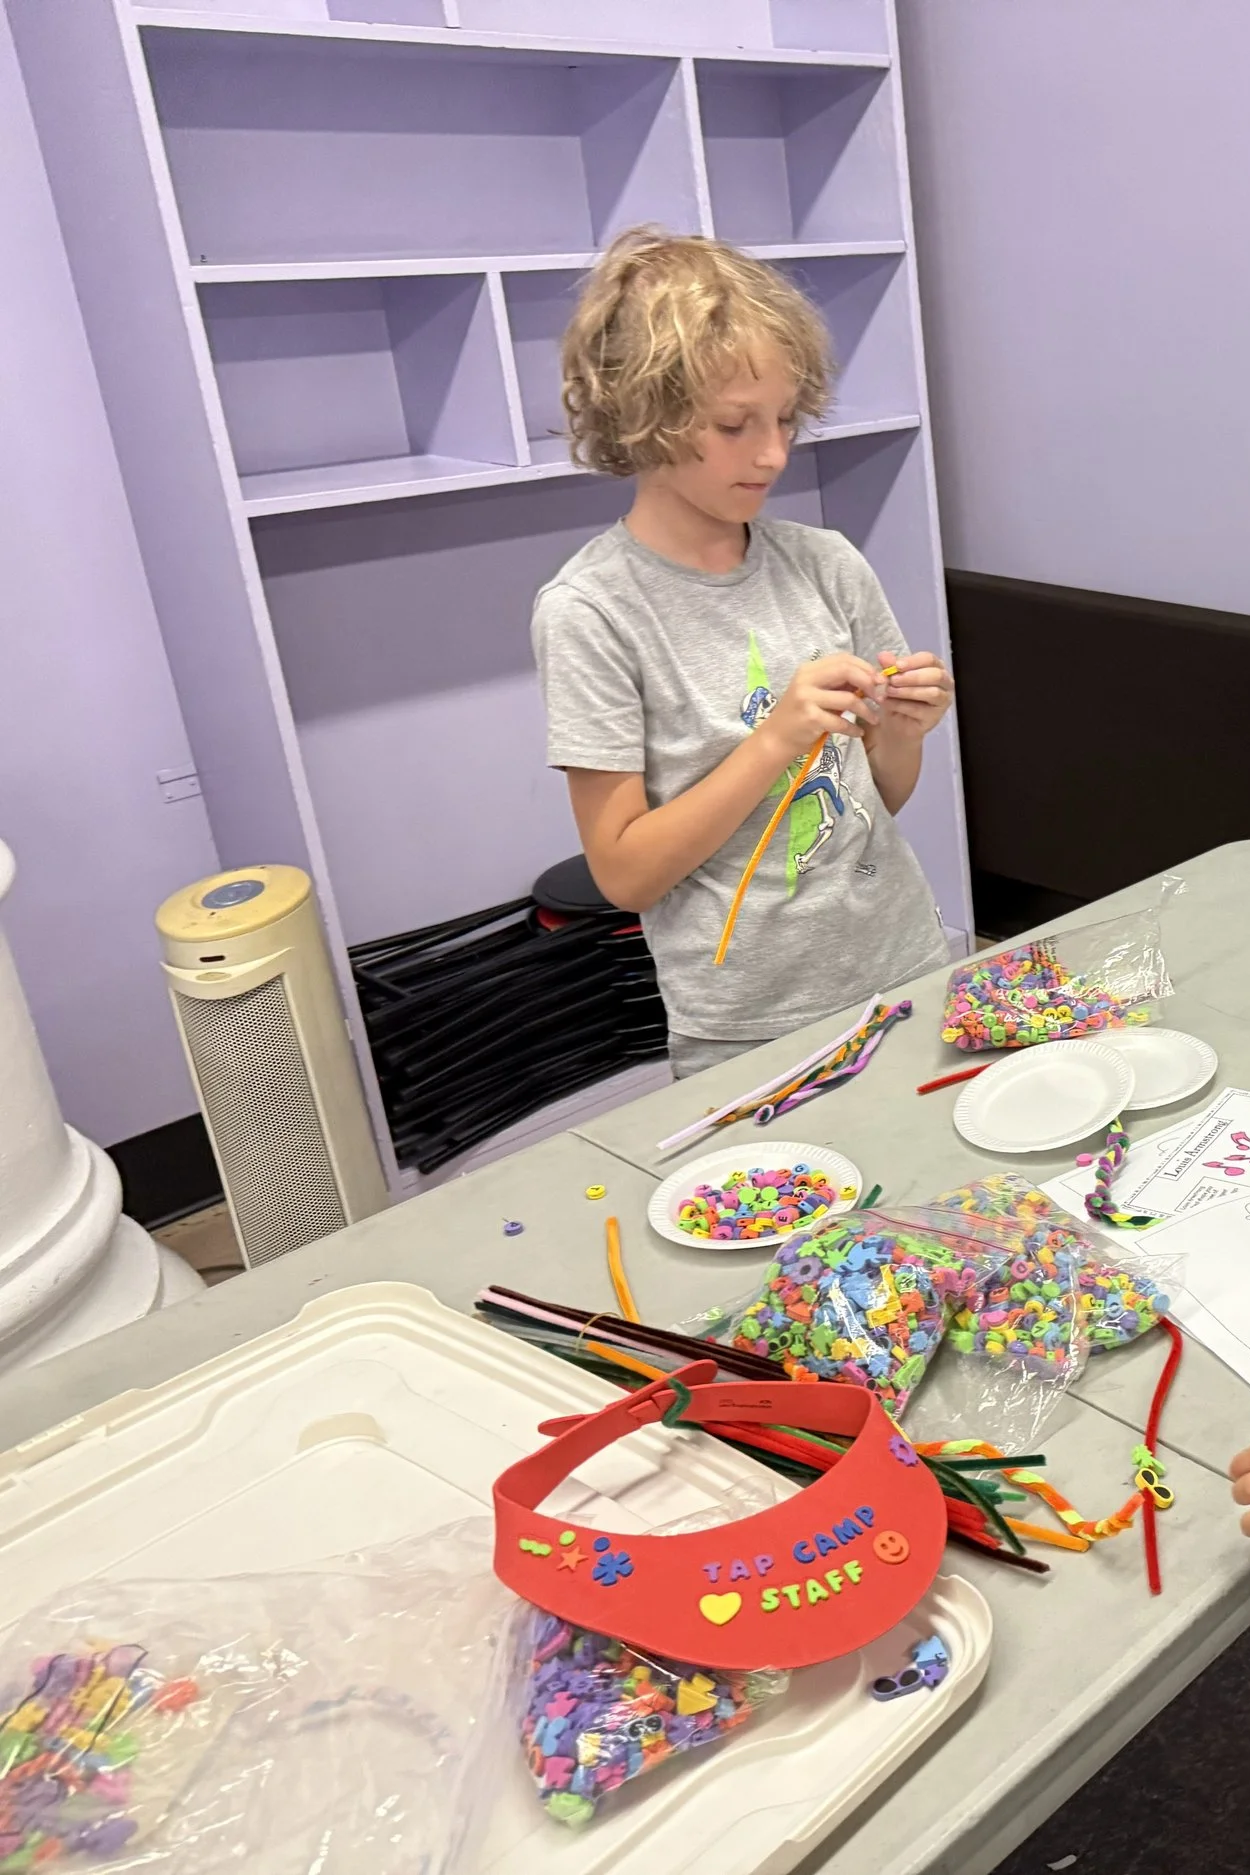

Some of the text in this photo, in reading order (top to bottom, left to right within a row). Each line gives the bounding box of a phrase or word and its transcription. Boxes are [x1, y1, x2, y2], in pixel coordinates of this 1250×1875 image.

[1164, 1120, 1228, 1177] Louis Armstrong
[702, 1505, 875, 1583] TAP CAMP
[761, 1560, 863, 1612] STAFF
